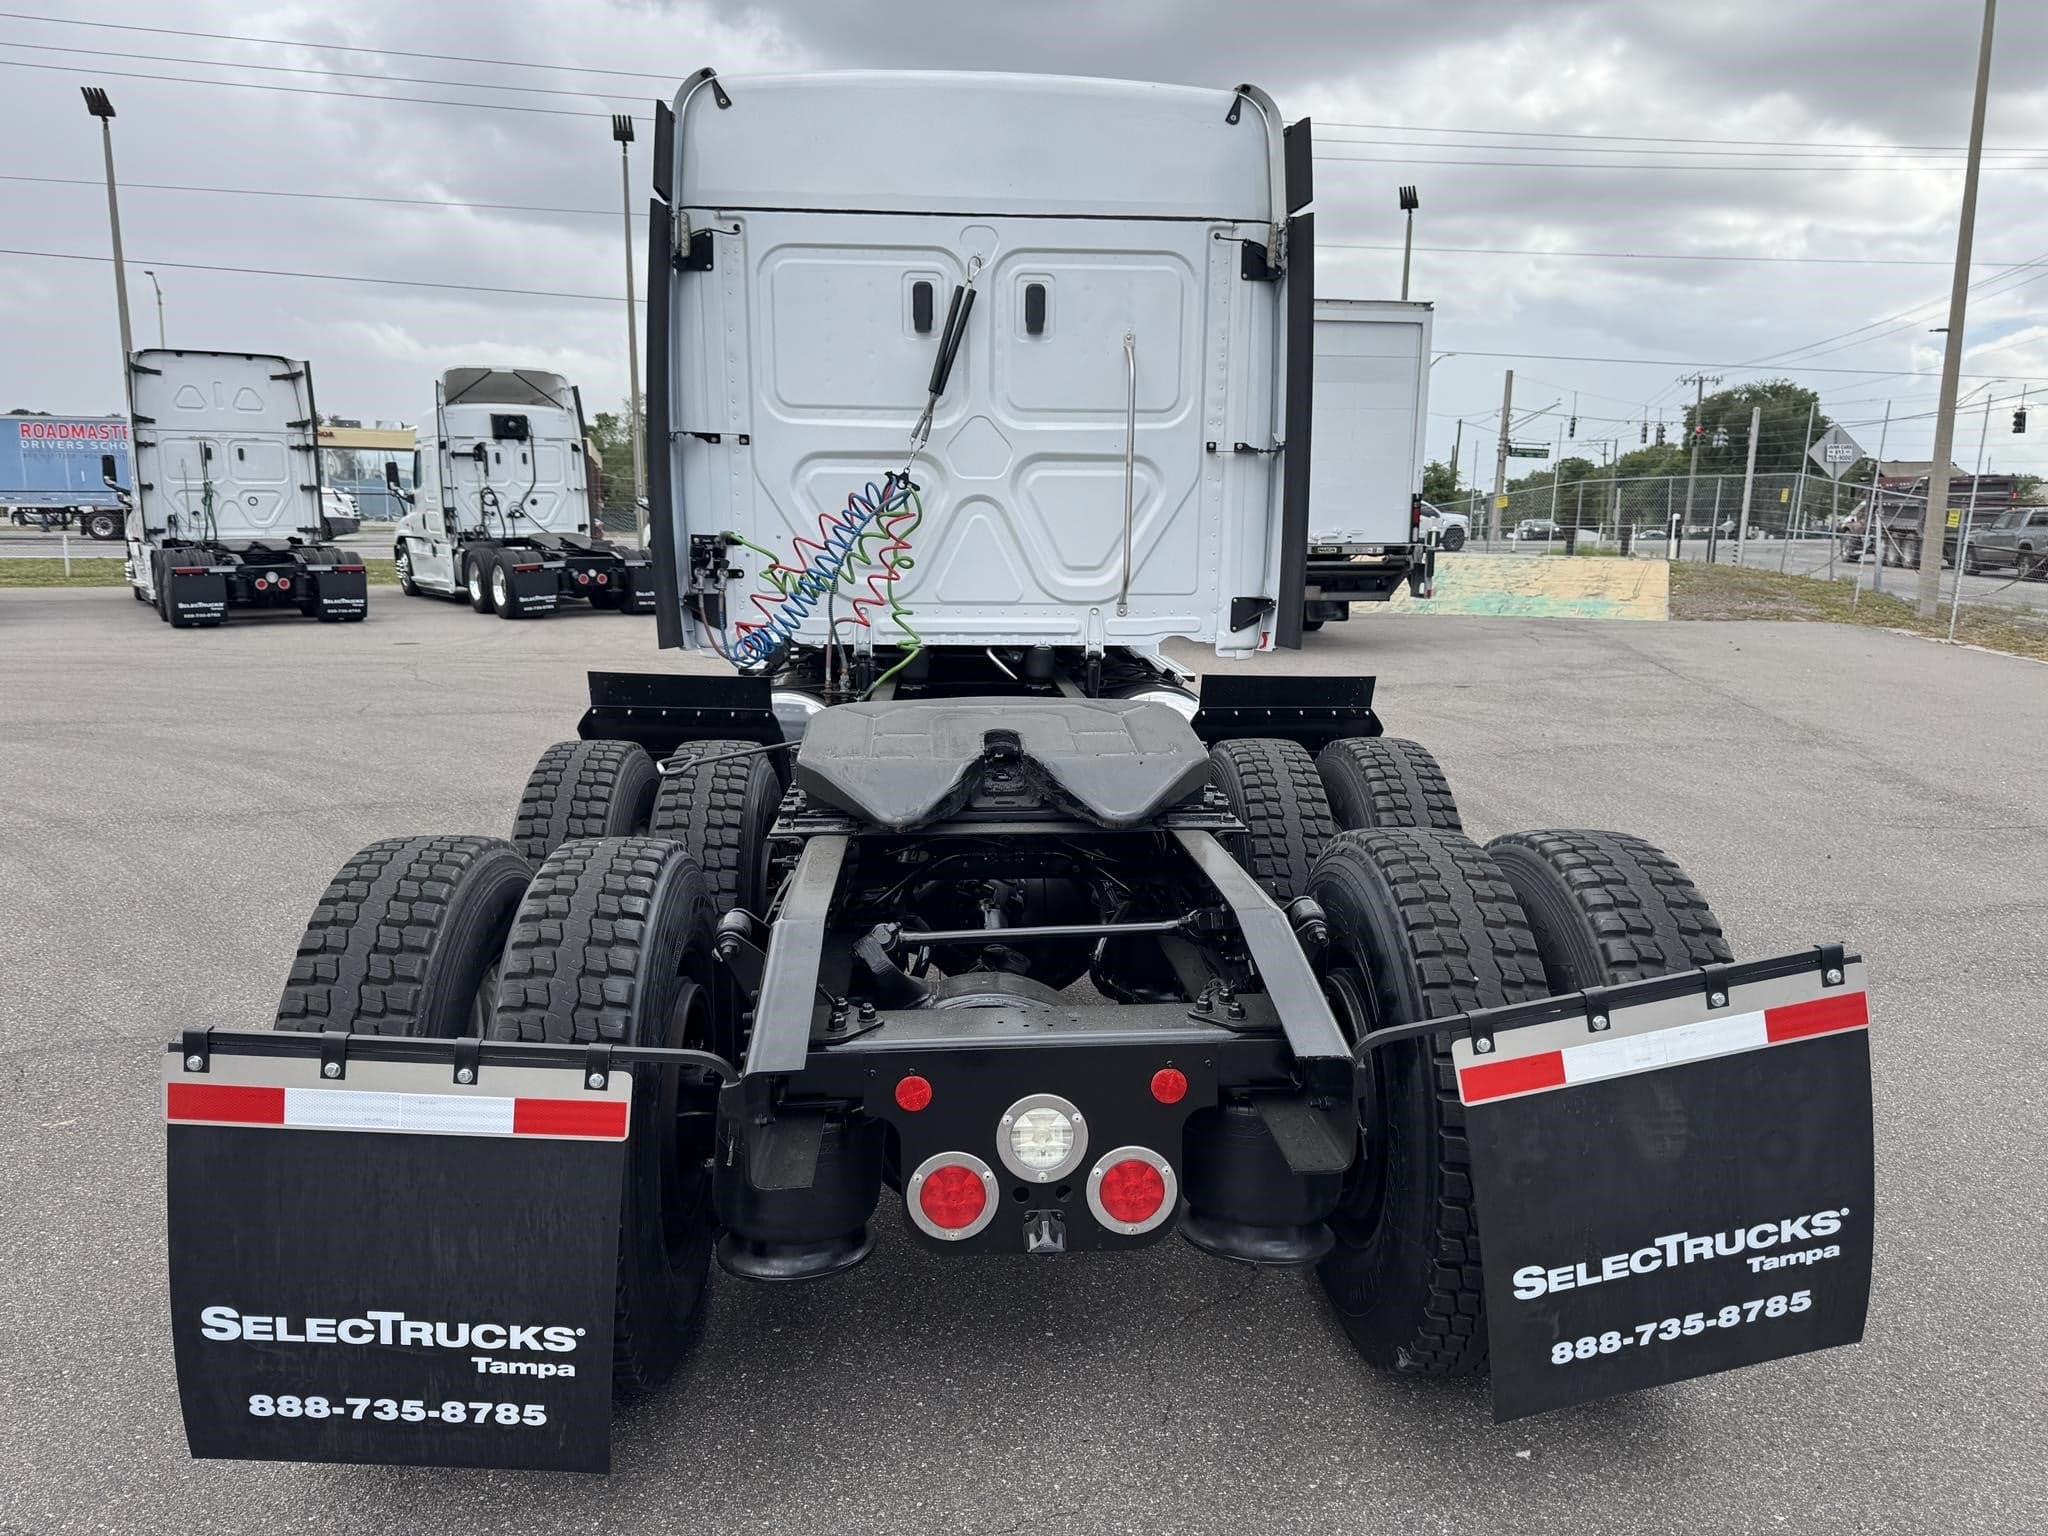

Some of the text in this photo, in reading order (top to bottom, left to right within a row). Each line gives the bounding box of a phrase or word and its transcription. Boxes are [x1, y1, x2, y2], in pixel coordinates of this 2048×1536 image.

[21, 440, 85, 450] DRIVERS
[1746, 1243, 1841, 1273] Tampa
[1551, 1290, 1812, 1365] 888-735-8785
[471, 1357, 576, 1379] Tampa
[248, 1395, 548, 1426] 888-735-8785
